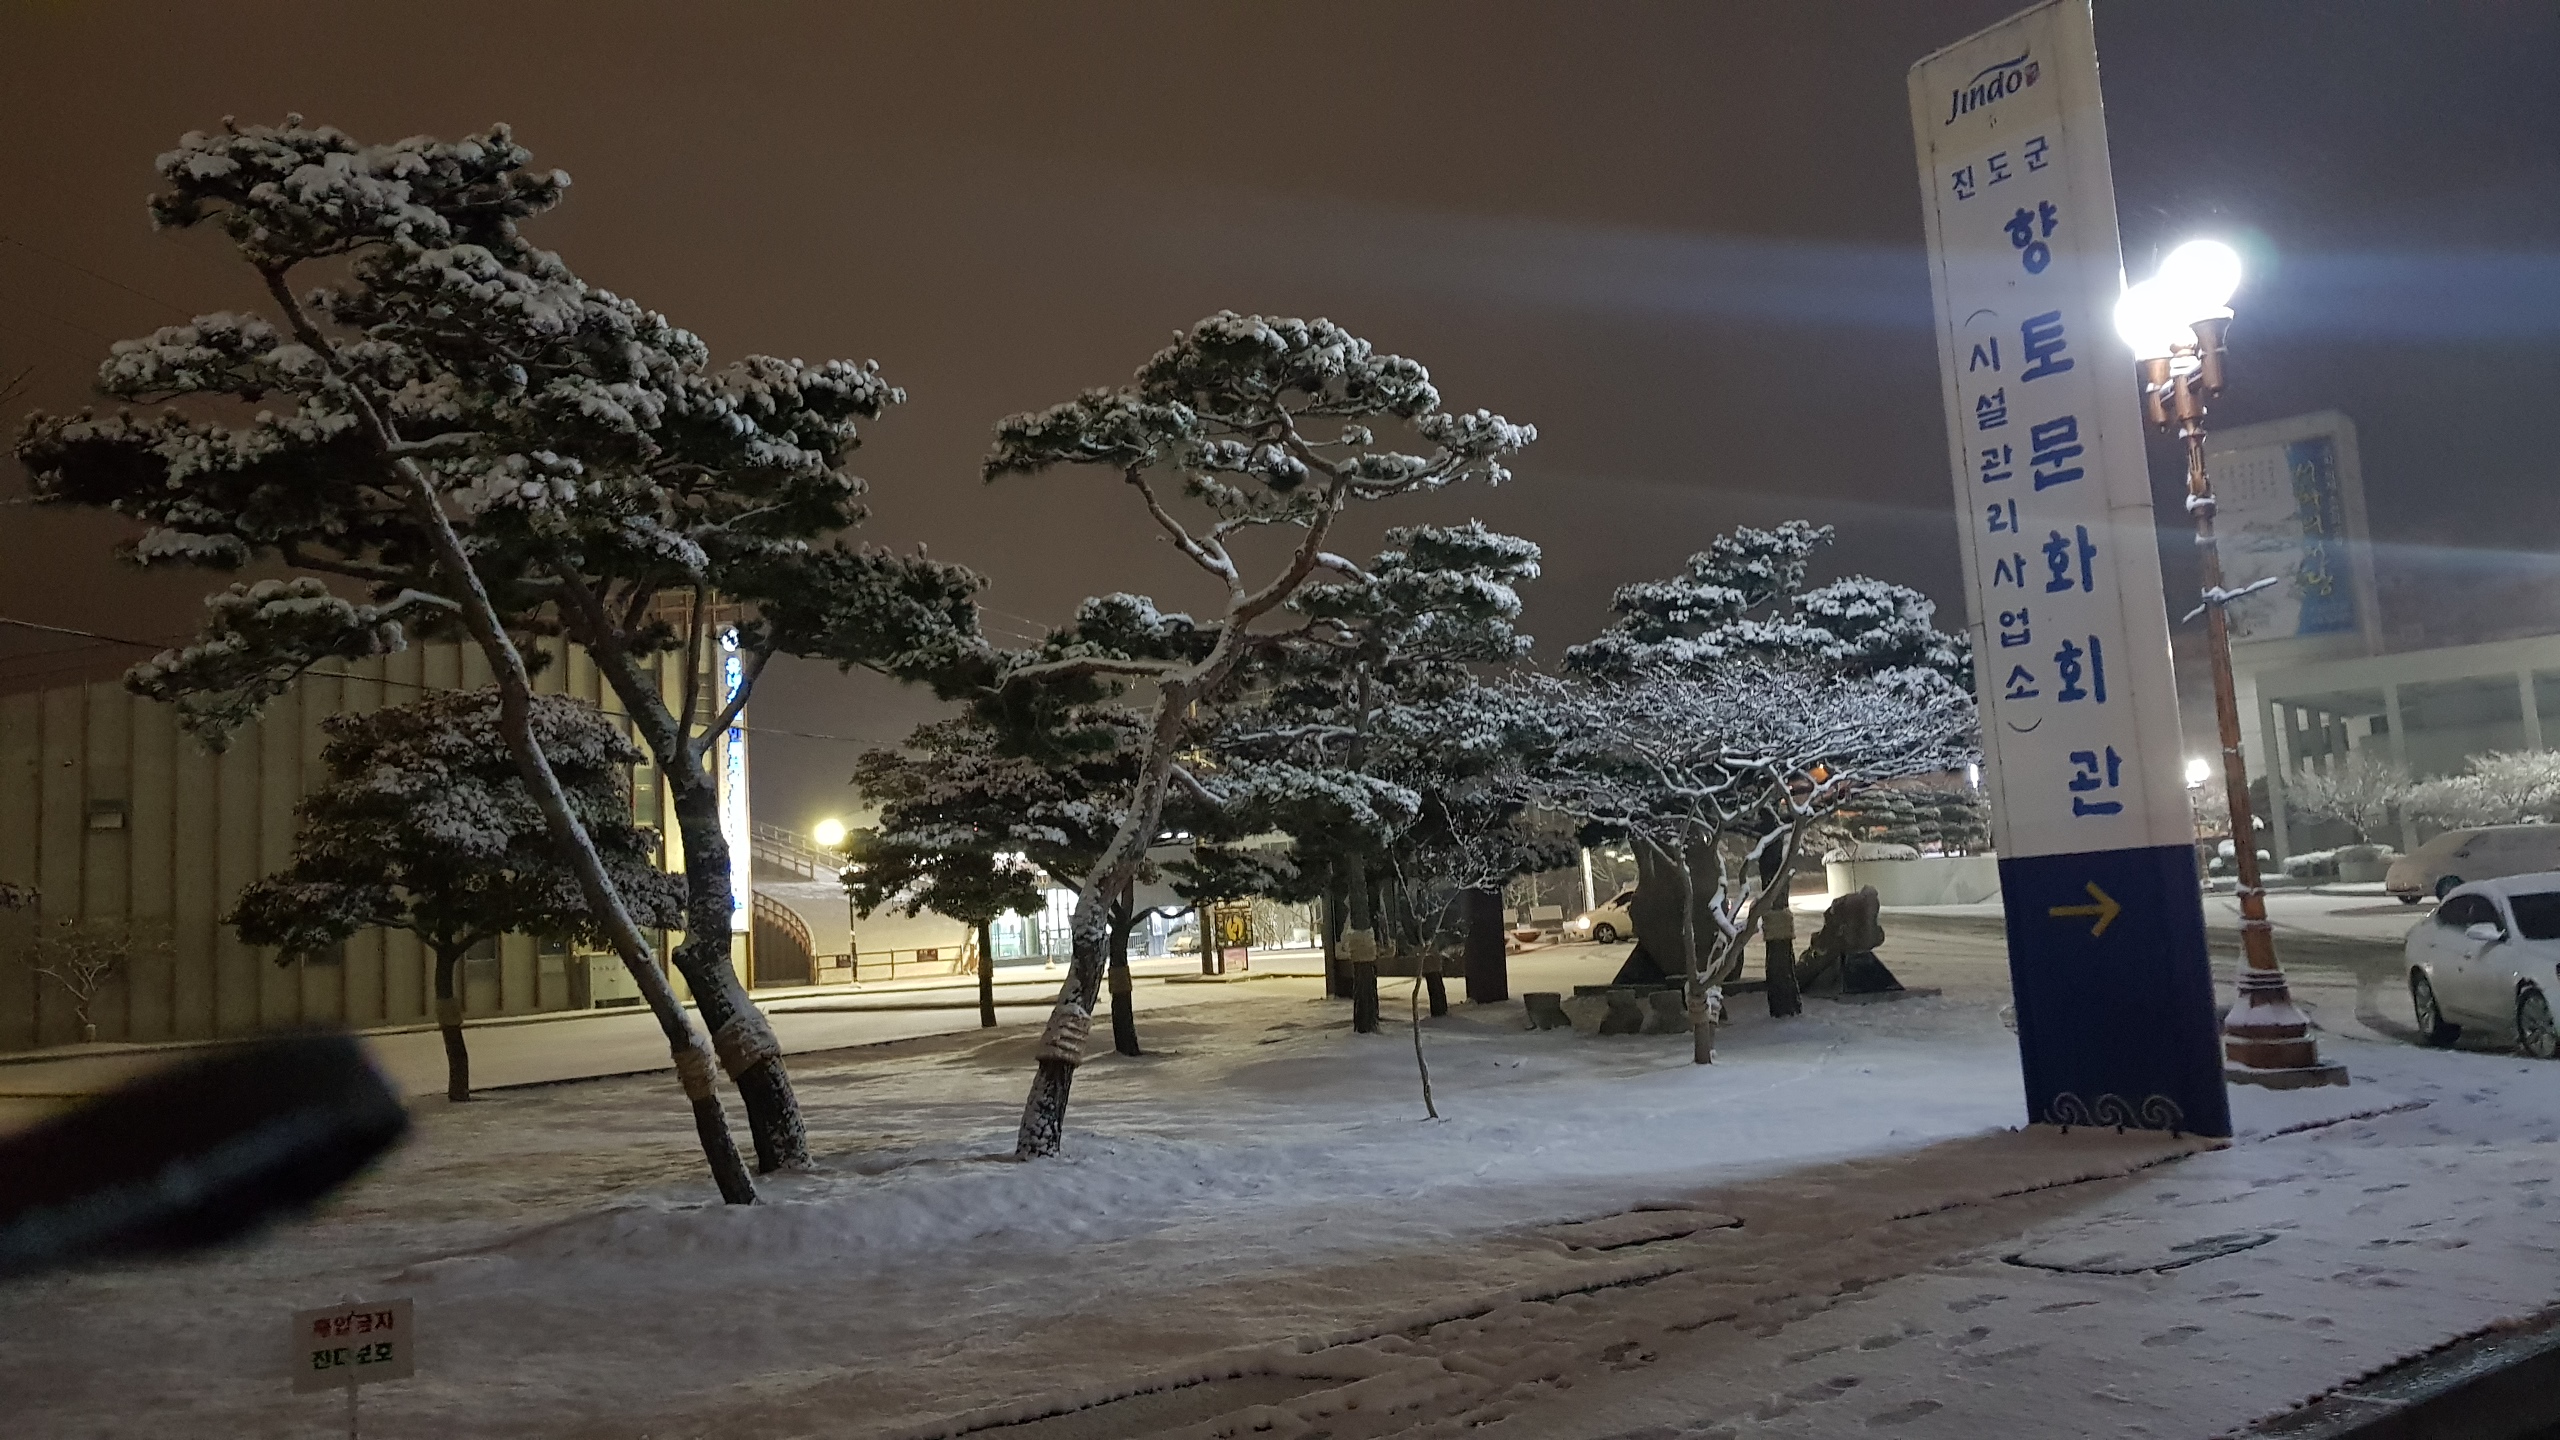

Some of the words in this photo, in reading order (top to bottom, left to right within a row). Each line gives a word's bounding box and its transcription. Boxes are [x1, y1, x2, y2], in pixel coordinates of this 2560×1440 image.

[1945, 70, 2023, 126] Jindo
[1951, 136, 2050, 201] 진도군
[2004, 200, 2124, 817] 향토문화회관
